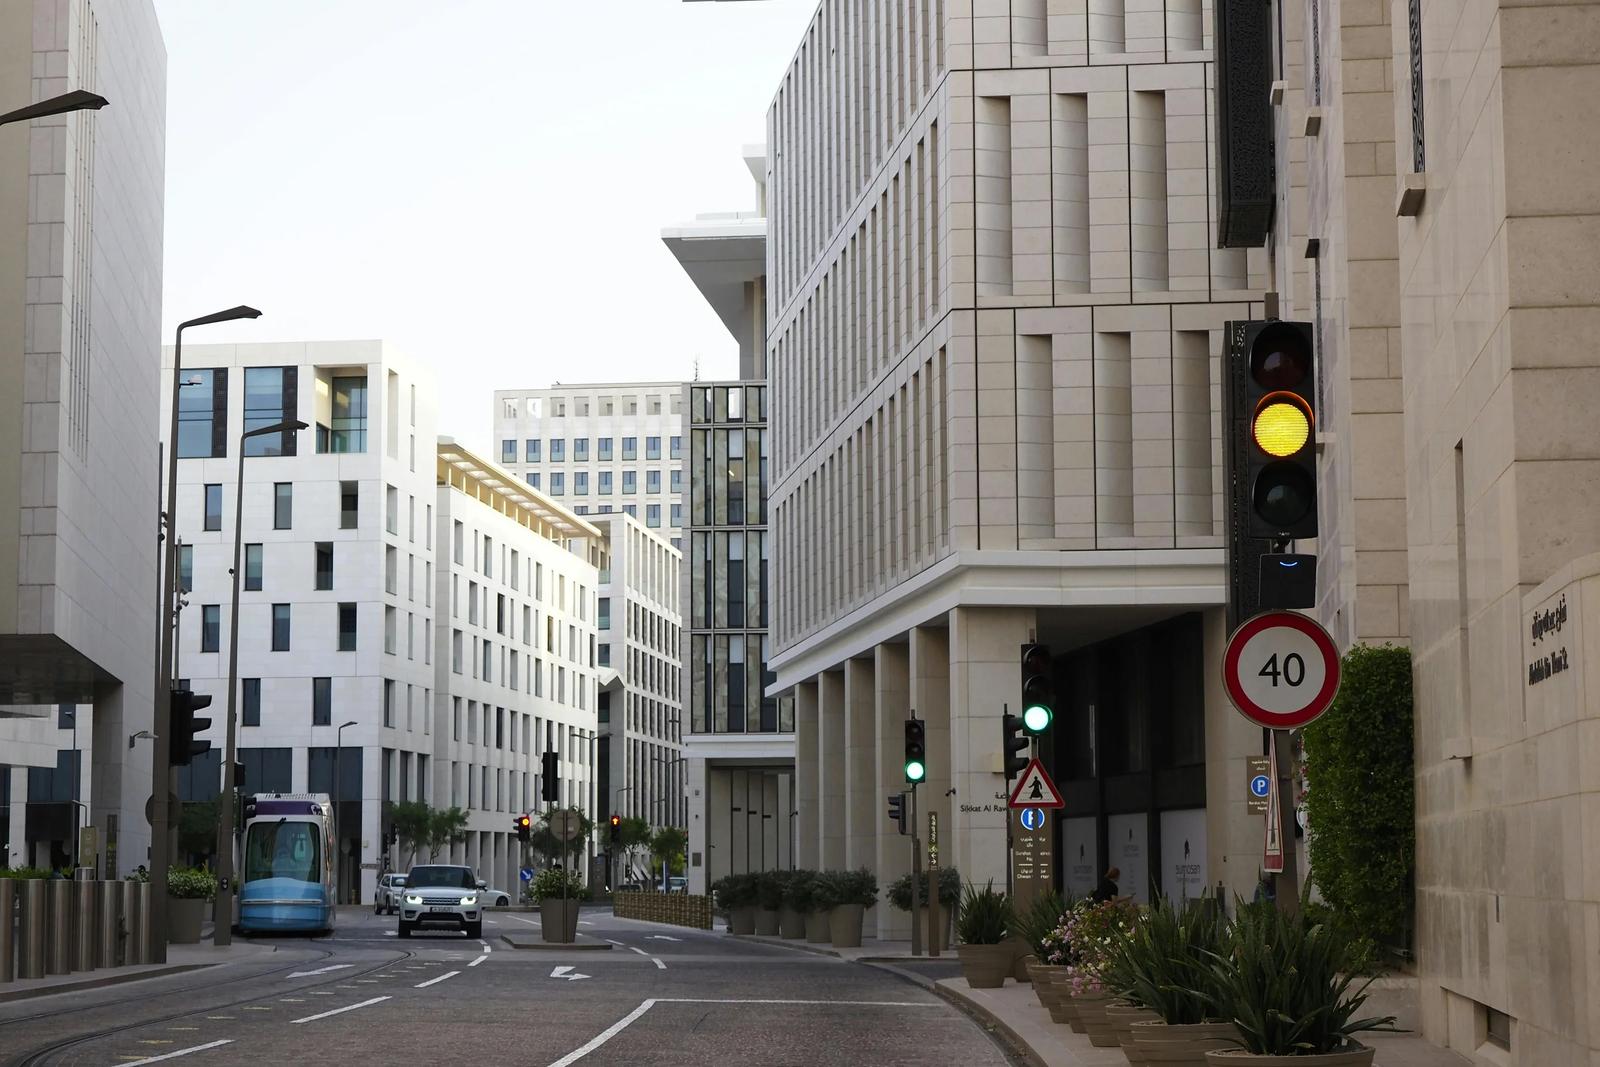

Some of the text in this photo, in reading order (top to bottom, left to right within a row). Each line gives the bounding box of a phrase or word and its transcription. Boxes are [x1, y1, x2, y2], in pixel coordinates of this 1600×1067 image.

[1258, 652, 1306, 687] 40
[1257, 779, 1266, 793] P
[983, 804, 992, 812] Al
[993, 804, 1008, 812] Raw
